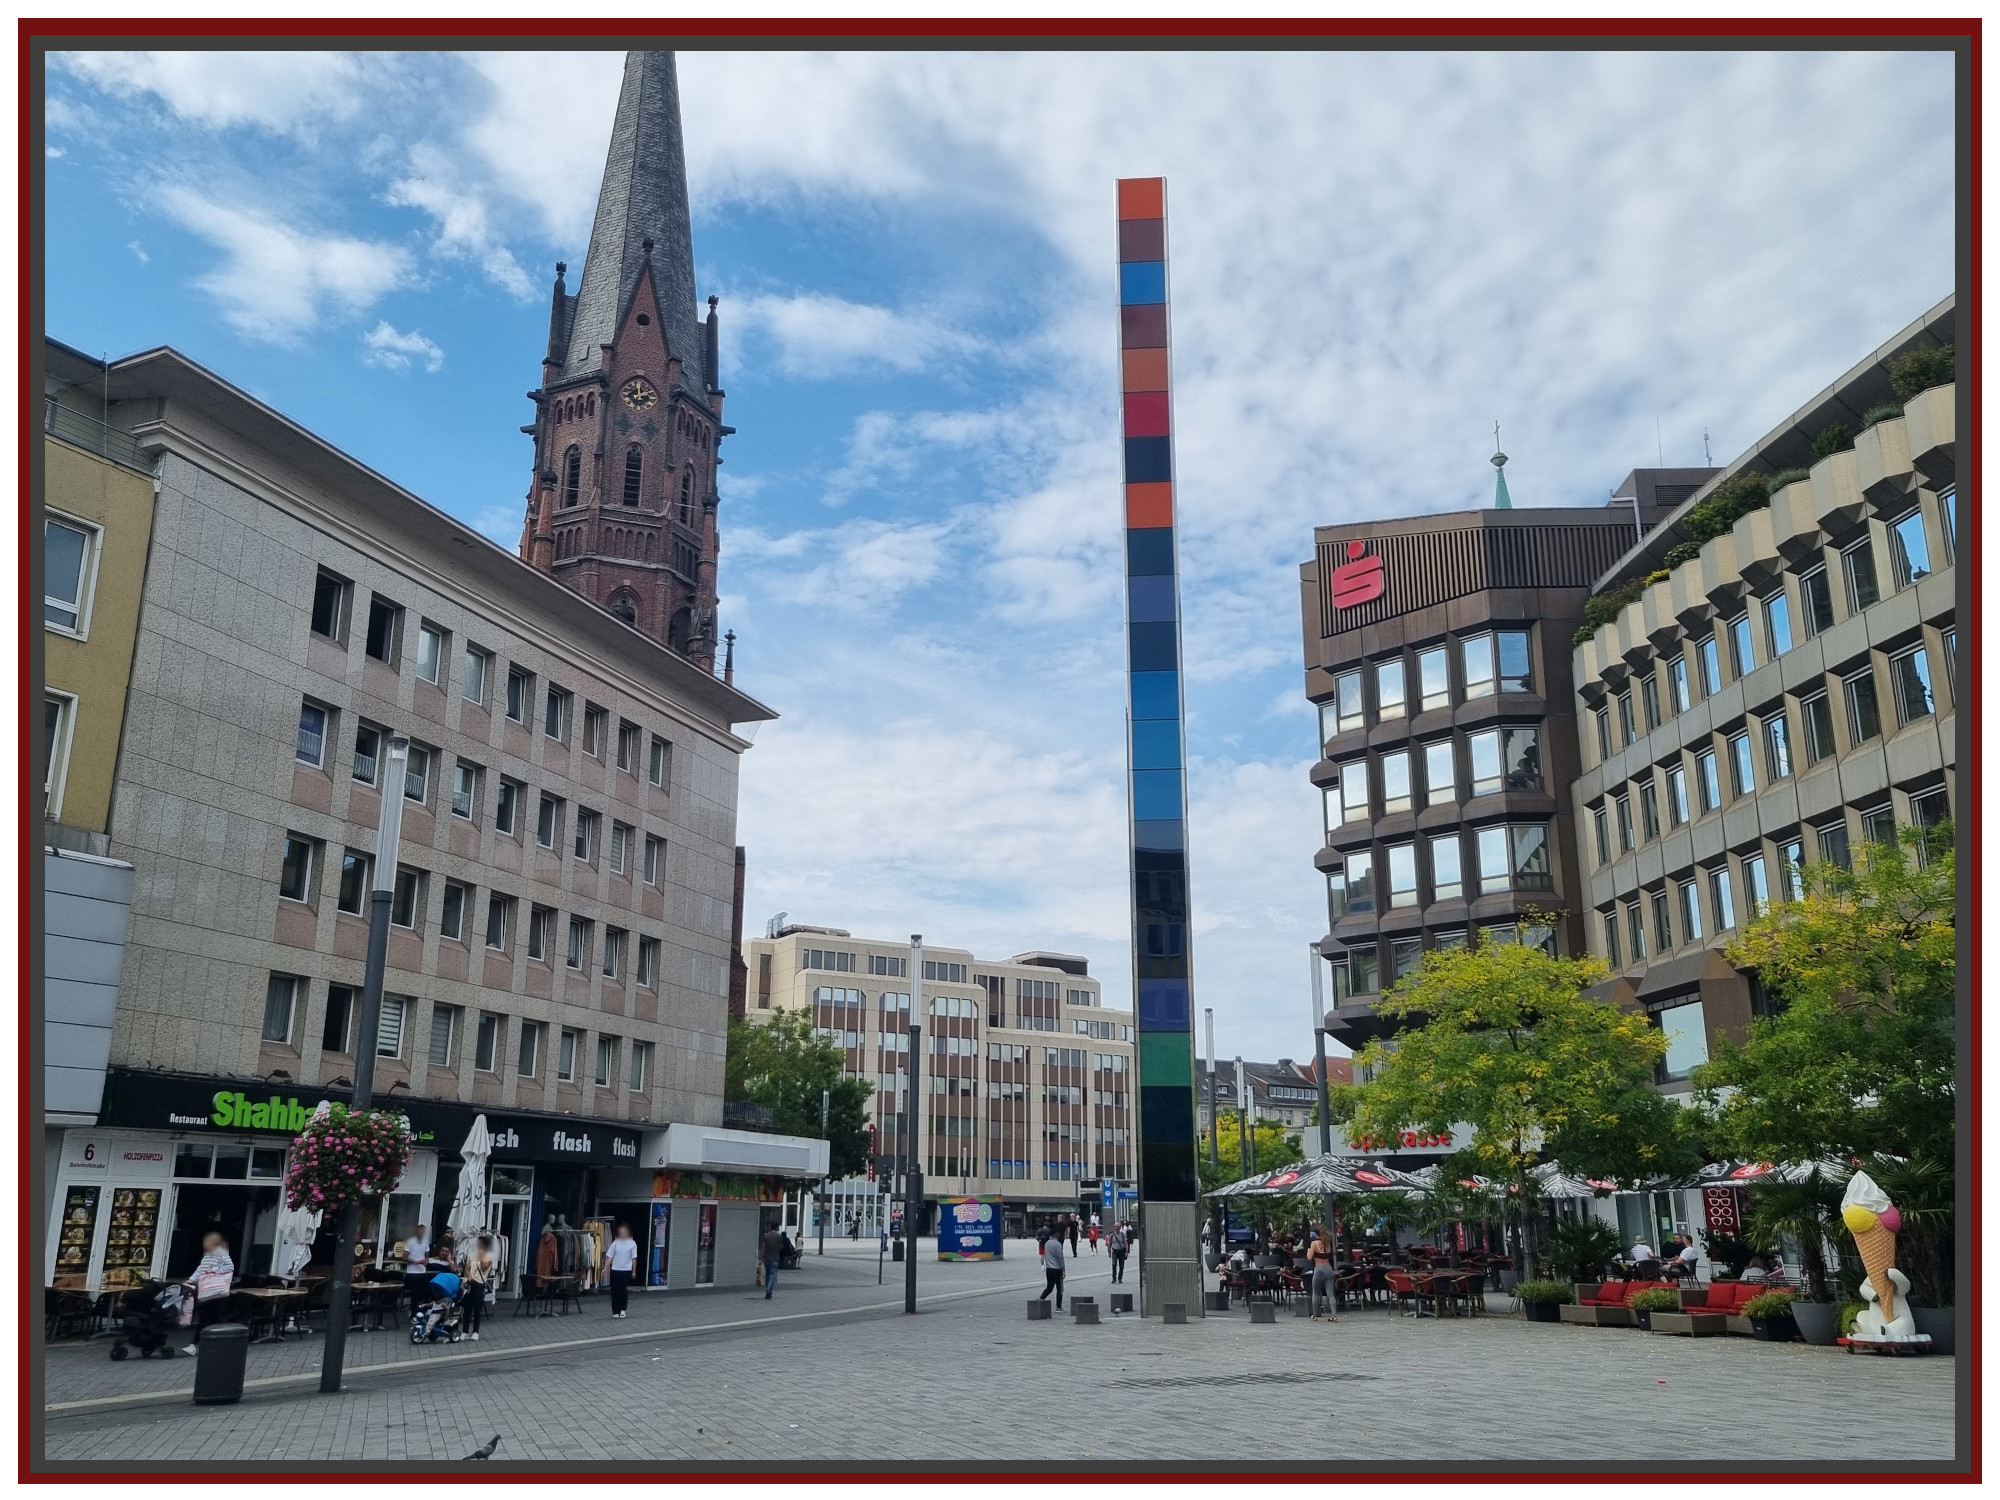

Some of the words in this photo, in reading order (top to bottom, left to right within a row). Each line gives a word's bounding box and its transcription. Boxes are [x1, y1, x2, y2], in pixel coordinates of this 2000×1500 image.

[169, 1112, 208, 1126] Restaurant
[488, 1128, 520, 1148] ash
[552, 1130, 592, 1153] flash
[84, 1143, 95, 1161] 6
[613, 1137, 636, 1158] flash
[658, 1156, 664, 1165] 6
[953, 1204, 992, 1223] 150
[960, 1236, 982, 1246] 150
